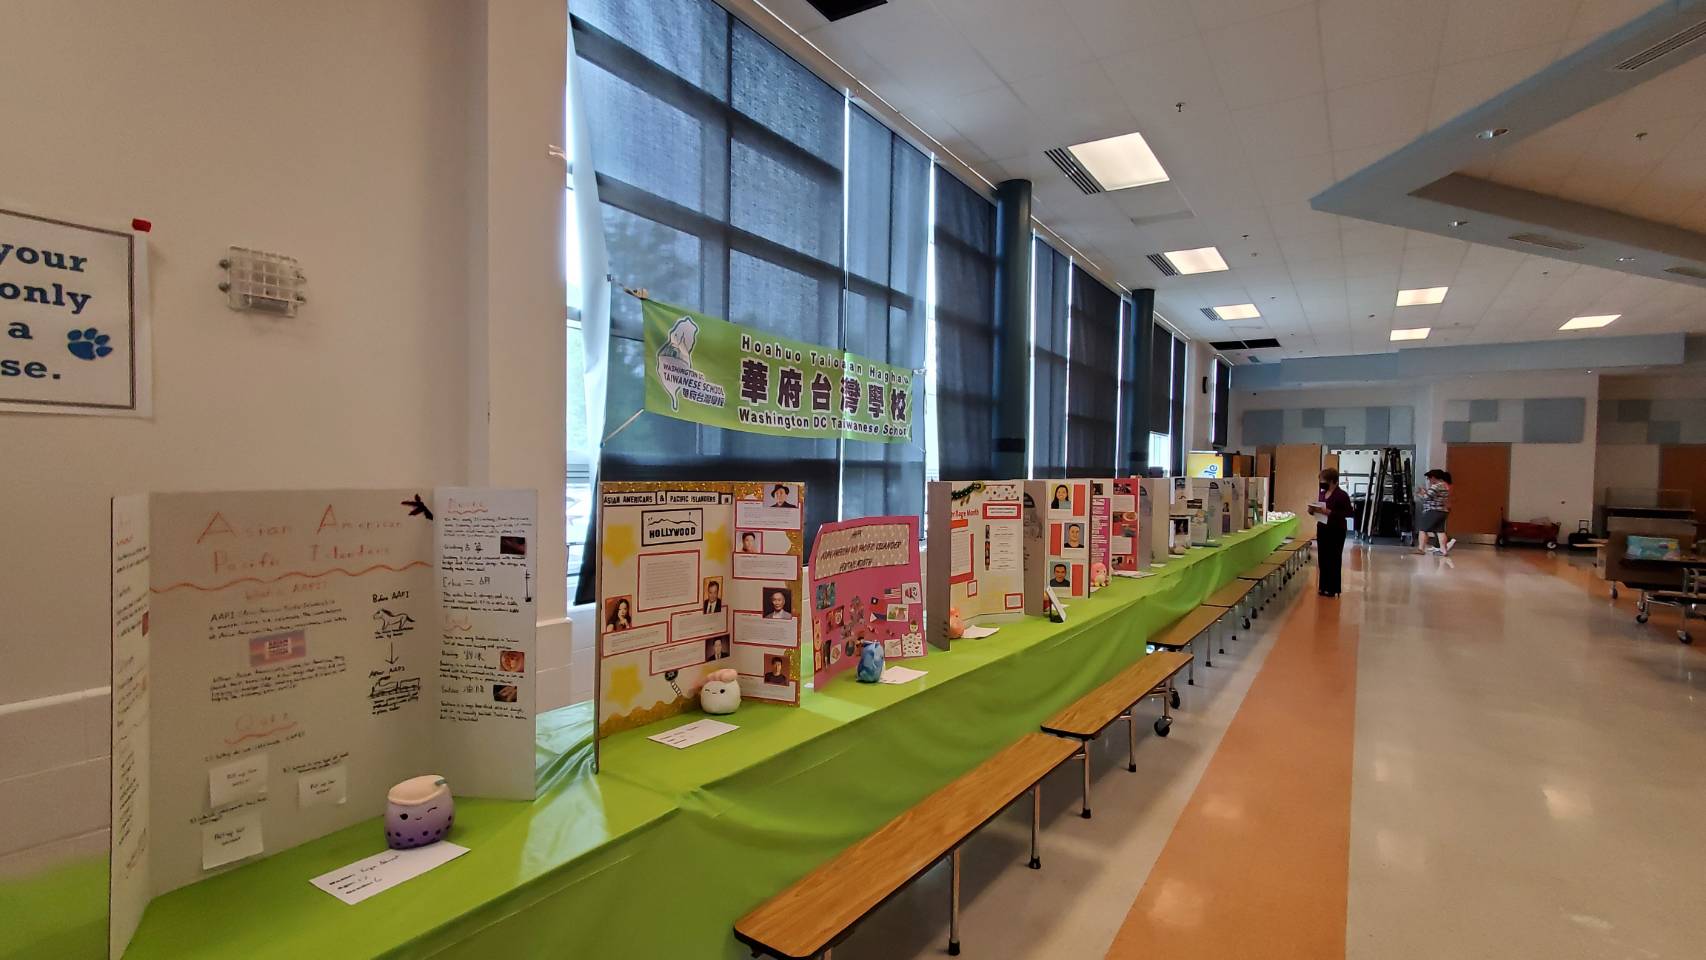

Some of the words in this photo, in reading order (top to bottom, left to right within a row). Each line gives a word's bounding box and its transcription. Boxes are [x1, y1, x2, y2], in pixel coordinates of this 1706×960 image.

[0, 282, 92, 314] only
[8, 321, 33, 340] a
[742, 335, 801, 362] Hoahuo
[664, 372, 702, 390] TAIWANESE
[741, 359, 907, 421] 華府台灣學校
[739, 408, 809, 429] Washington
[814, 416, 827, 429] DC
[832, 417, 879, 434] Taiwanese
[649, 527, 696, 539] HOLLYWOOD
